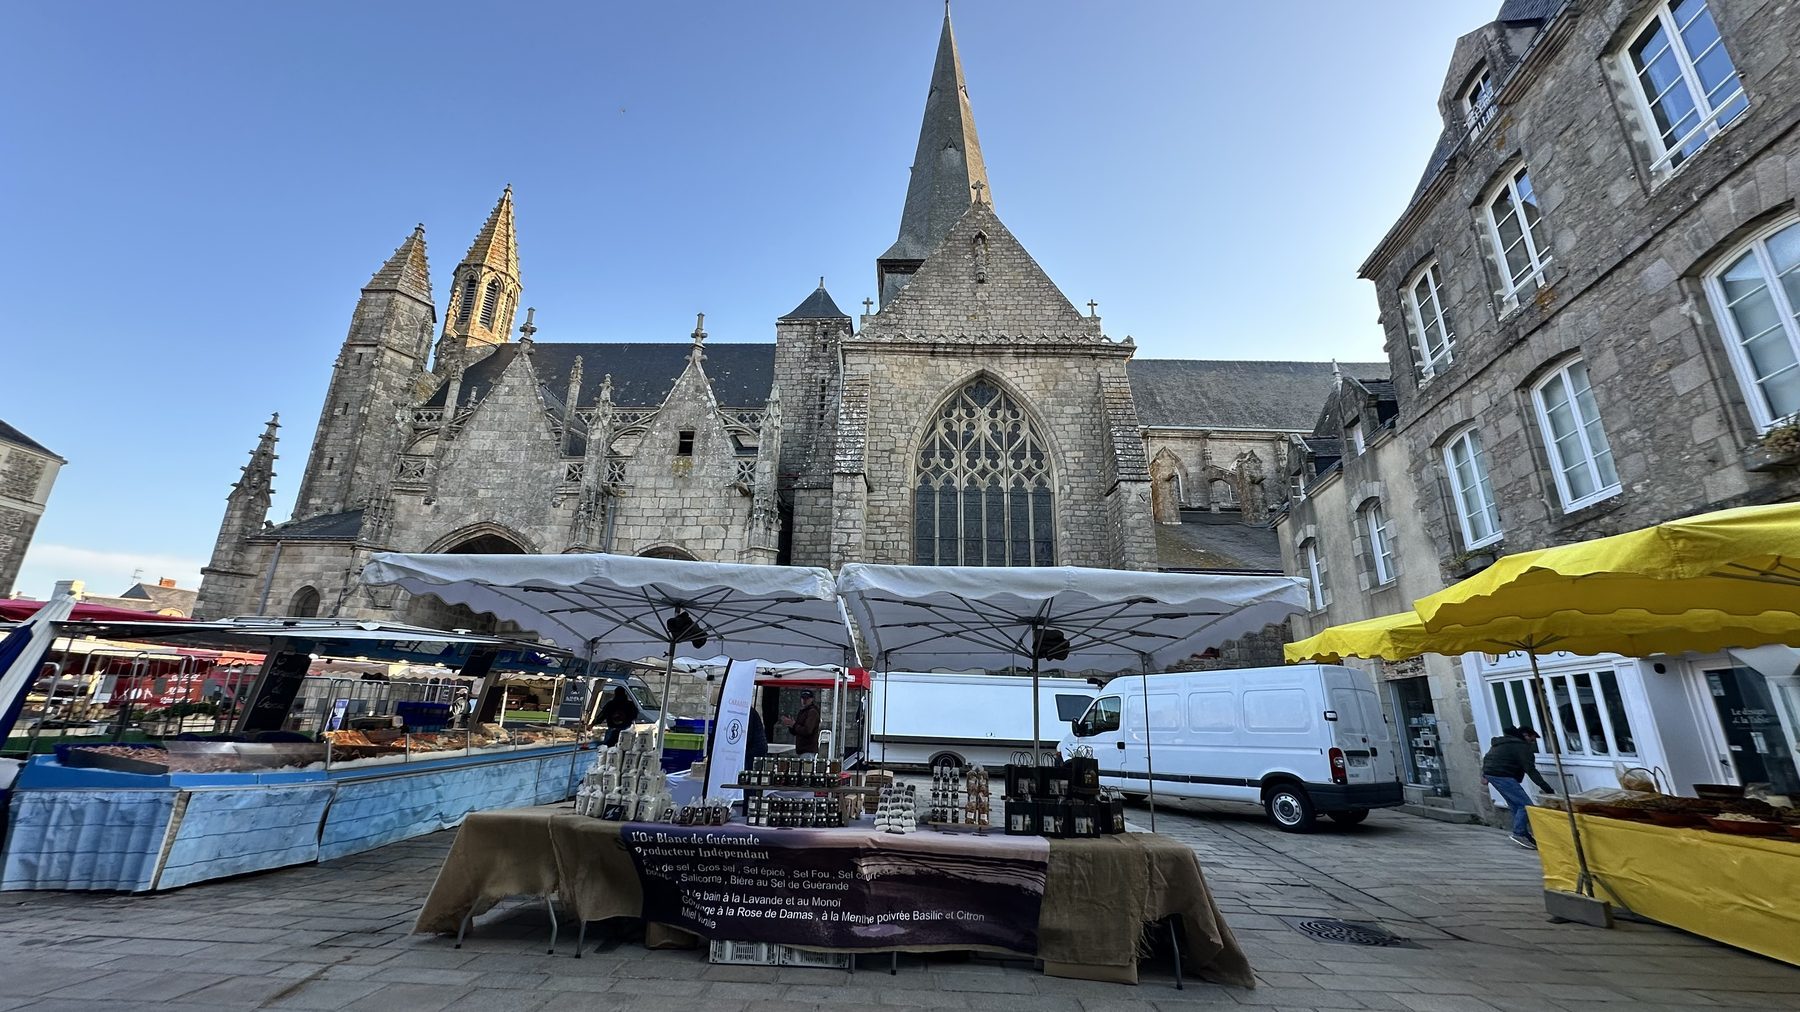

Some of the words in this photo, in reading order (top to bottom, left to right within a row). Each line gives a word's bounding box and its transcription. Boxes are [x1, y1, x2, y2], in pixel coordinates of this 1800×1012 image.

[631, 830, 653, 843] L'Or
[656, 832, 688, 844] Blanc
[690, 833, 704, 845] de
[706, 833, 760, 846] Guérande
[634, 846, 696, 857] Producteur
[699, 847, 770, 860] Indépendant
[661, 863, 674, 873] de
[676, 863, 690, 872] sel
[697, 863, 721, 873] Gros
[722, 864, 736, 874] sel
[743, 866, 758, 875] Sel
[760, 867, 785, 878] épicé
[793, 869, 809, 879] Sel
[811, 869, 830, 879] Fou
[838, 870, 854, 879] Sel
[730, 874, 754, 886] Bière
[756, 878, 768, 887] au
[770, 878, 786, 888] Sel
[787, 880, 800, 889] de
[802, 880, 849, 891] Guérande
[703, 890, 721, 902] bain
[722, 892, 729, 903] à
[731, 892, 740, 903] la
[742, 893, 783, 905] Lavande
[785, 896, 795, 906] et
[797, 897, 809, 906] au
[811, 896, 841, 908] Monoï
[717, 905, 724, 916] à
[725, 906, 734, 917] la
[736, 906, 763, 918] Rose
[764, 908, 777, 918] de
[779, 908, 813, 920] Damas
[821, 910, 828, 921] à
[830, 910, 839, 921] la
[841, 911, 875, 925] Menthe
[876, 910, 911, 925] poivrée
[912, 910, 943, 921] Basilic
[944, 911, 955, 919] et
[956, 910, 985, 922] Citron
